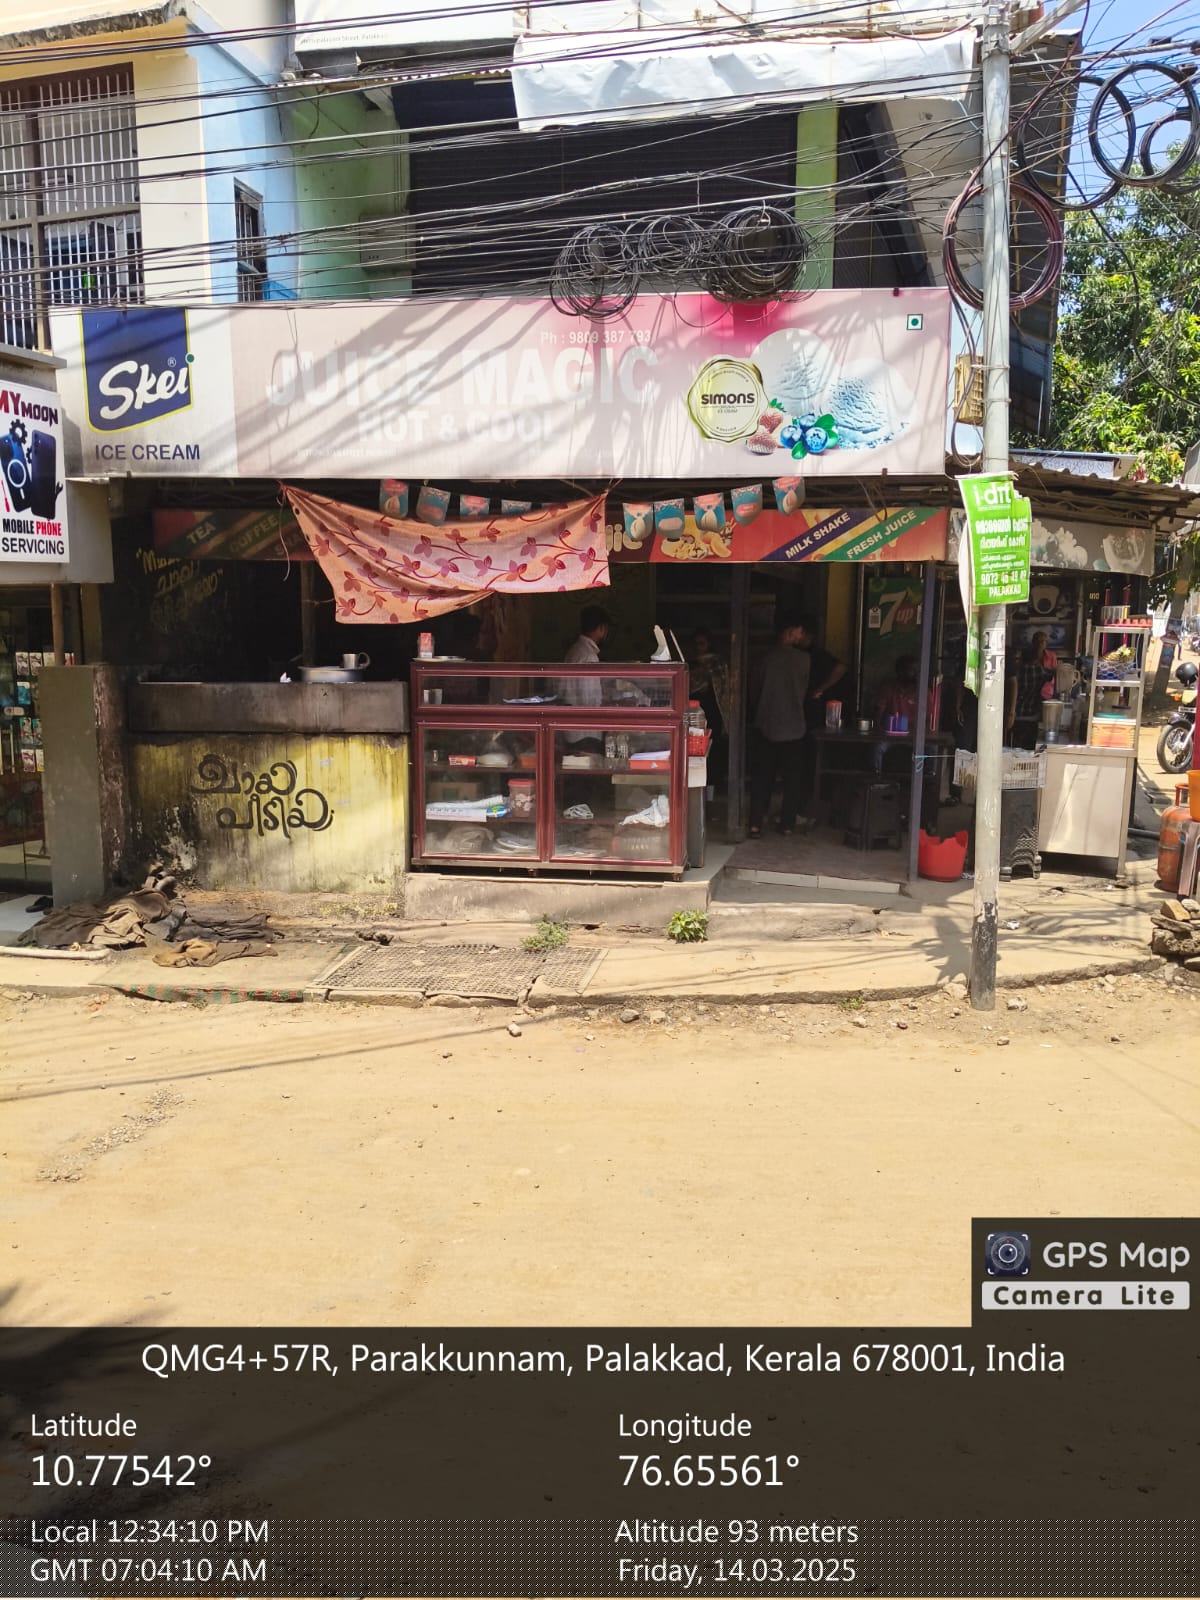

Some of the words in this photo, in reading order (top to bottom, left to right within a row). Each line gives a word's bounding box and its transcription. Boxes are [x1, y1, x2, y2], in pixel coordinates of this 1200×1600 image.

[541, 332, 557, 345] Ph
[604, 330, 625, 344] 387
[630, 330, 652, 342] 793
[265, 348, 440, 407] JUICE
[462, 344, 661, 407] MAGIC
[358, 411, 430, 443] HOT
[438, 412, 461, 442] &
[95, 444, 126, 461] ICE
[131, 444, 200, 461] CREAM
[3, 518, 35, 534] MOBILE
[36, 520, 62, 537] PHONE
[186, 521, 217, 545] TEA
[229, 513, 280, 553] COFFEE
[784, 537, 815, 560] MILK
[813, 512, 851, 542] SHAKE
[846, 531, 884, 560] FRESH
[884, 510, 918, 536] JUICE
[1, 537, 65, 555] SERVICING
[989, 583, 1022, 599] PALAKKAD
